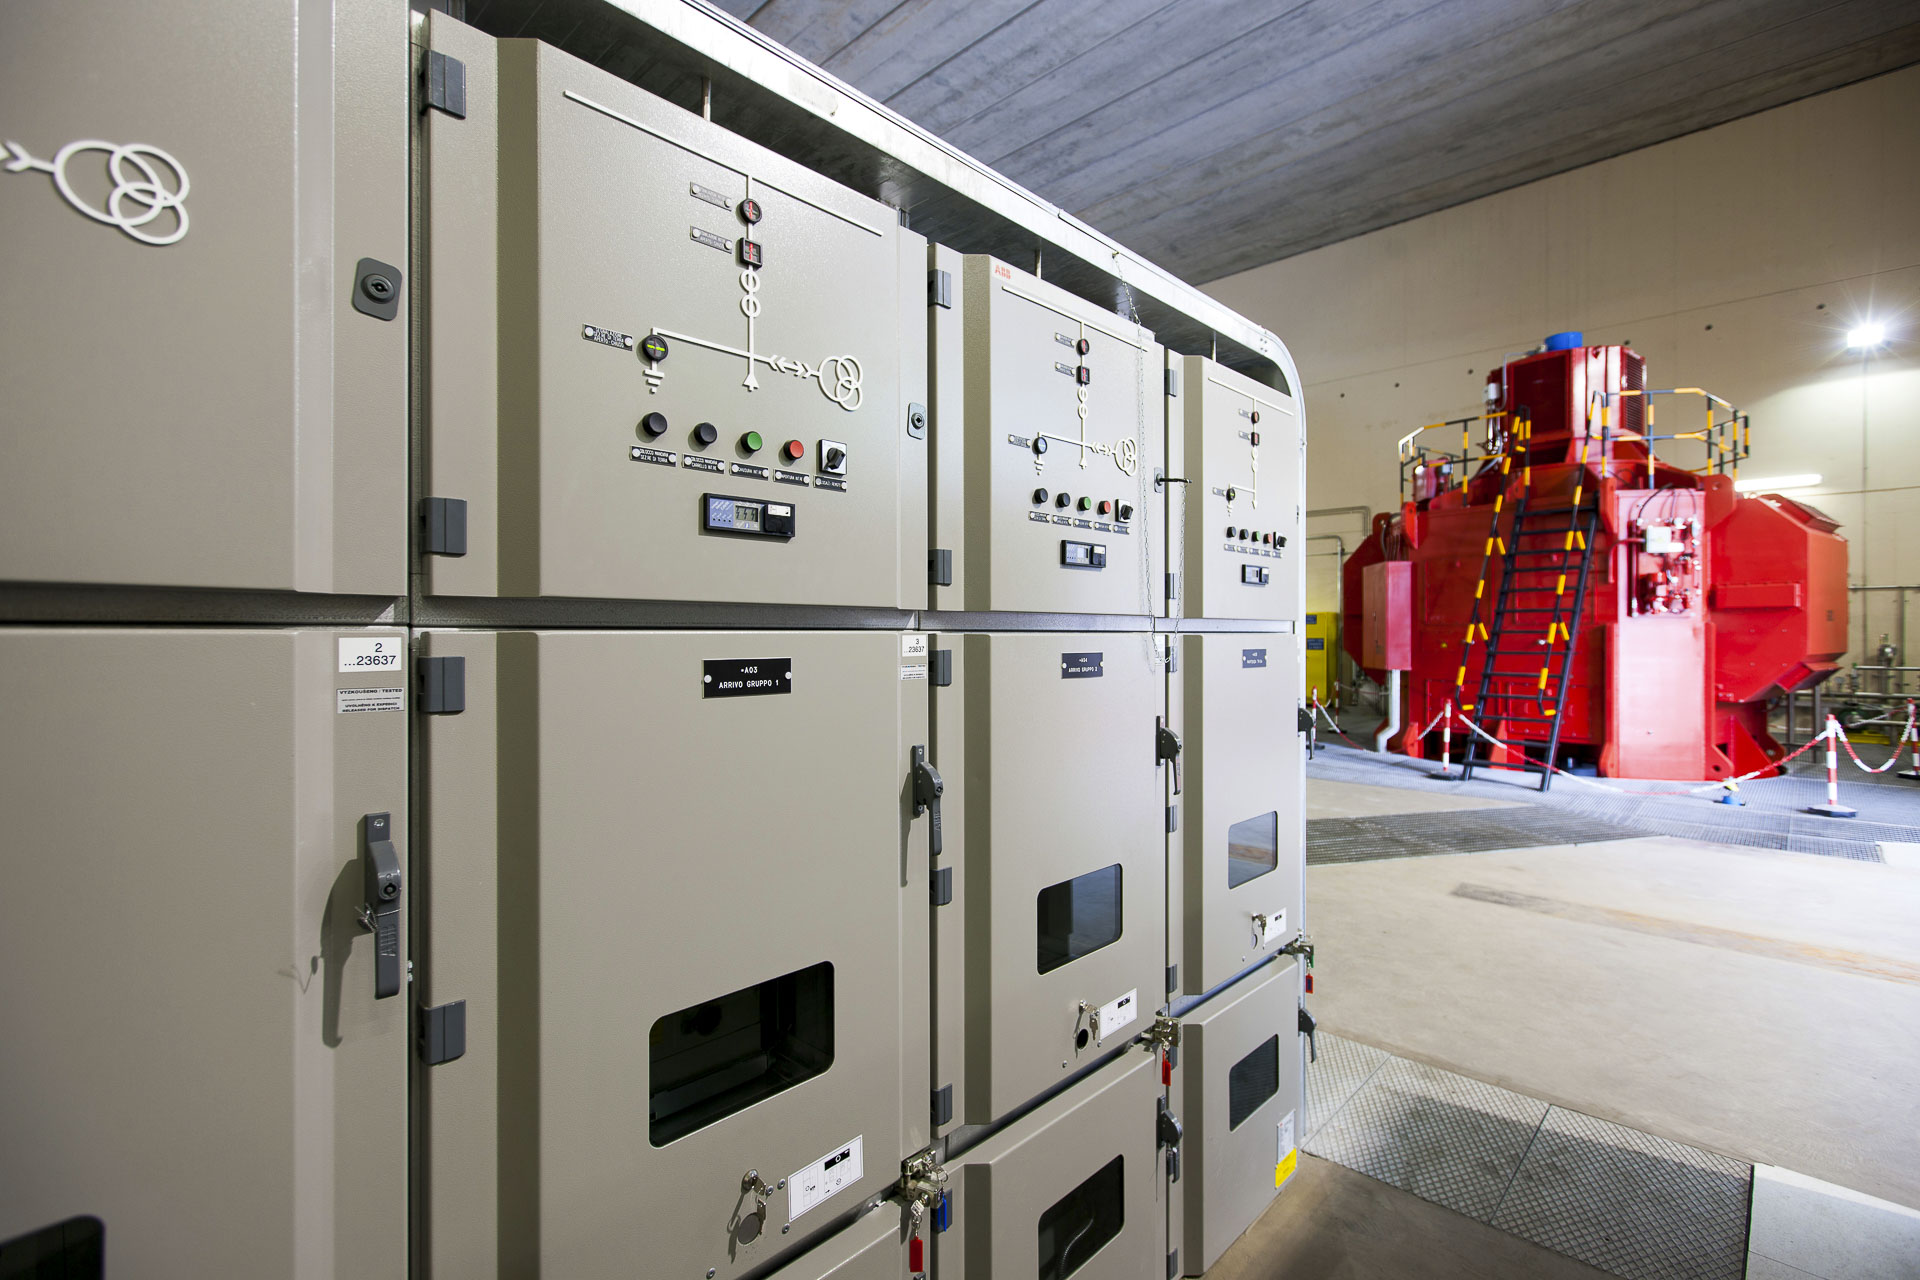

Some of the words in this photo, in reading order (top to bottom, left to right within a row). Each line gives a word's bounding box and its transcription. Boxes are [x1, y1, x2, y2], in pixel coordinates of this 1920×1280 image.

[994, 264, 1011, 280] ABB
[375, 642, 383, 653] 2
[718, 680, 743, 689] ARRIVO
[746, 679, 772, 688] GRUPPO
